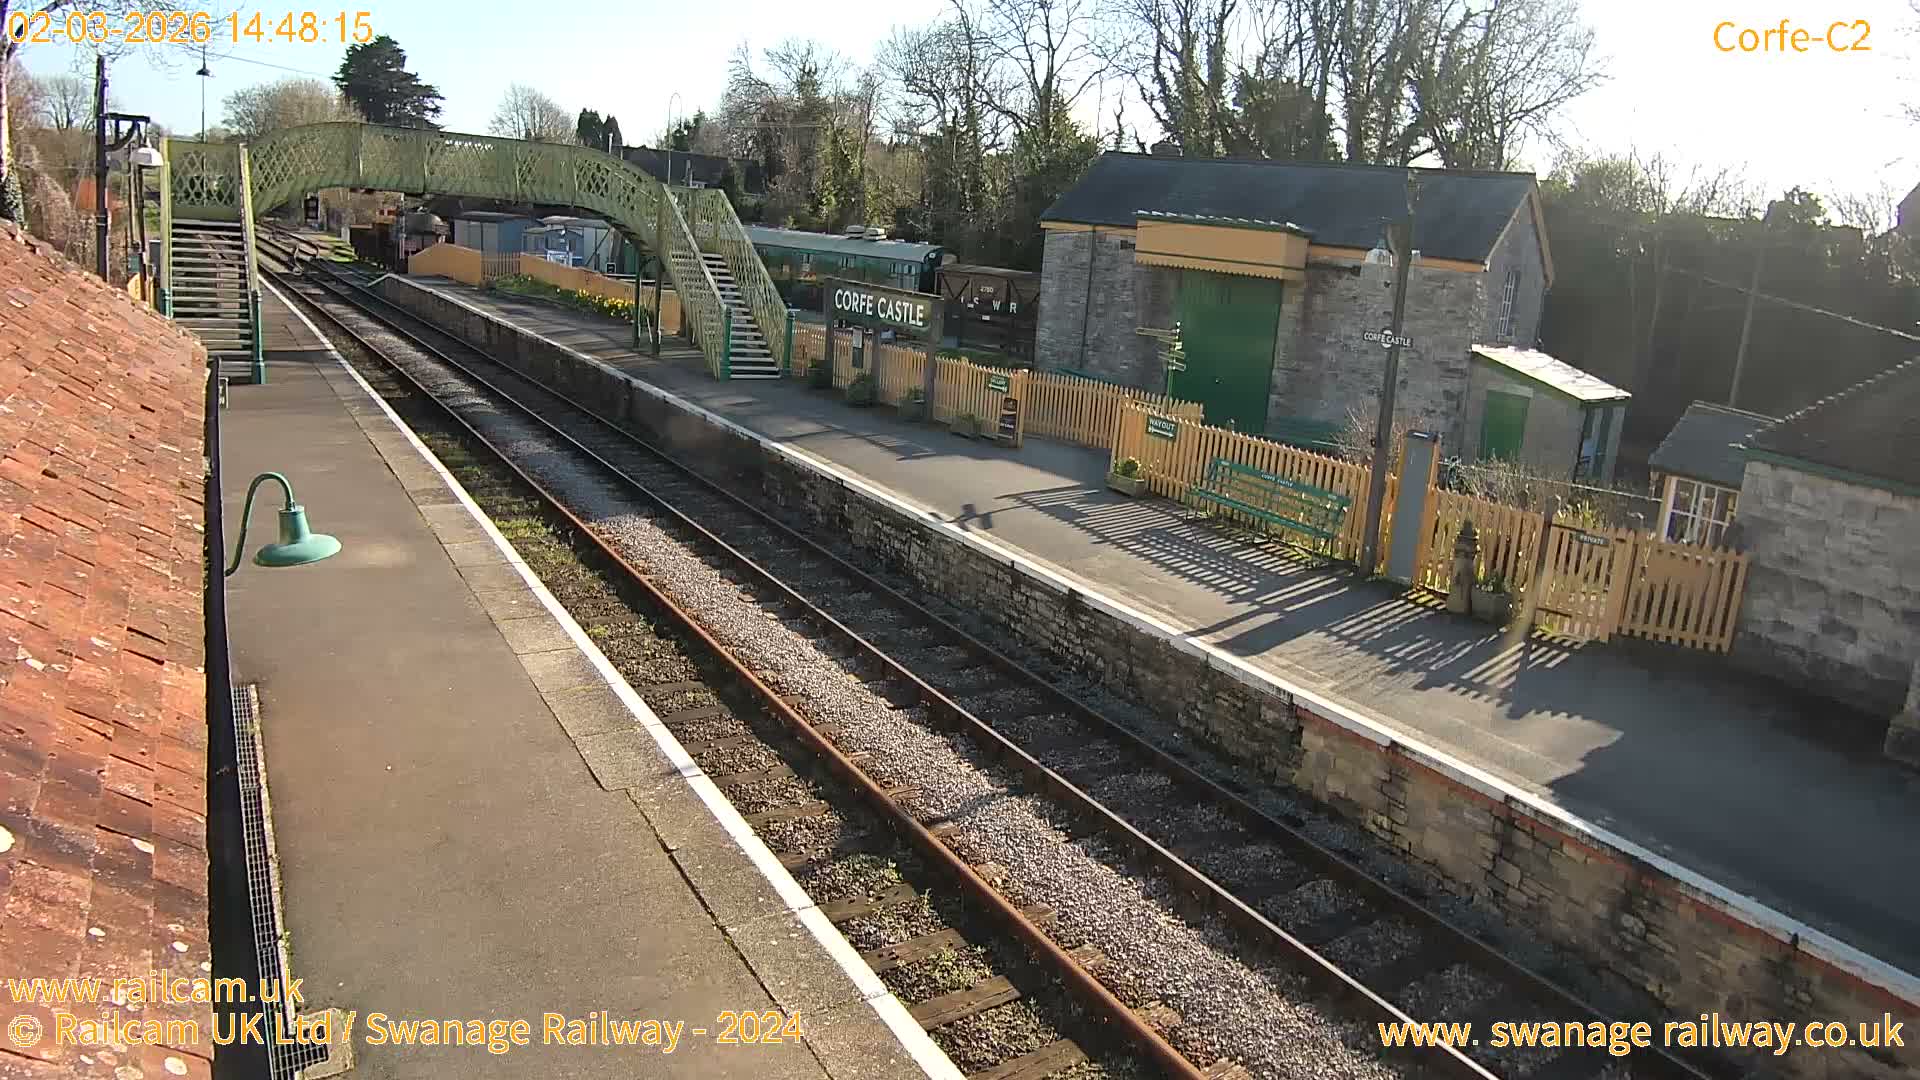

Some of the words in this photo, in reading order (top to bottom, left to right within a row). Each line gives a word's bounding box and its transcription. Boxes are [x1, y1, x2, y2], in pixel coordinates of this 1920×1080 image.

[835, 289, 874, 316] CORFE
[877, 297, 924, 327] CASTLE
[1363, 332, 1386, 343] CORFE
